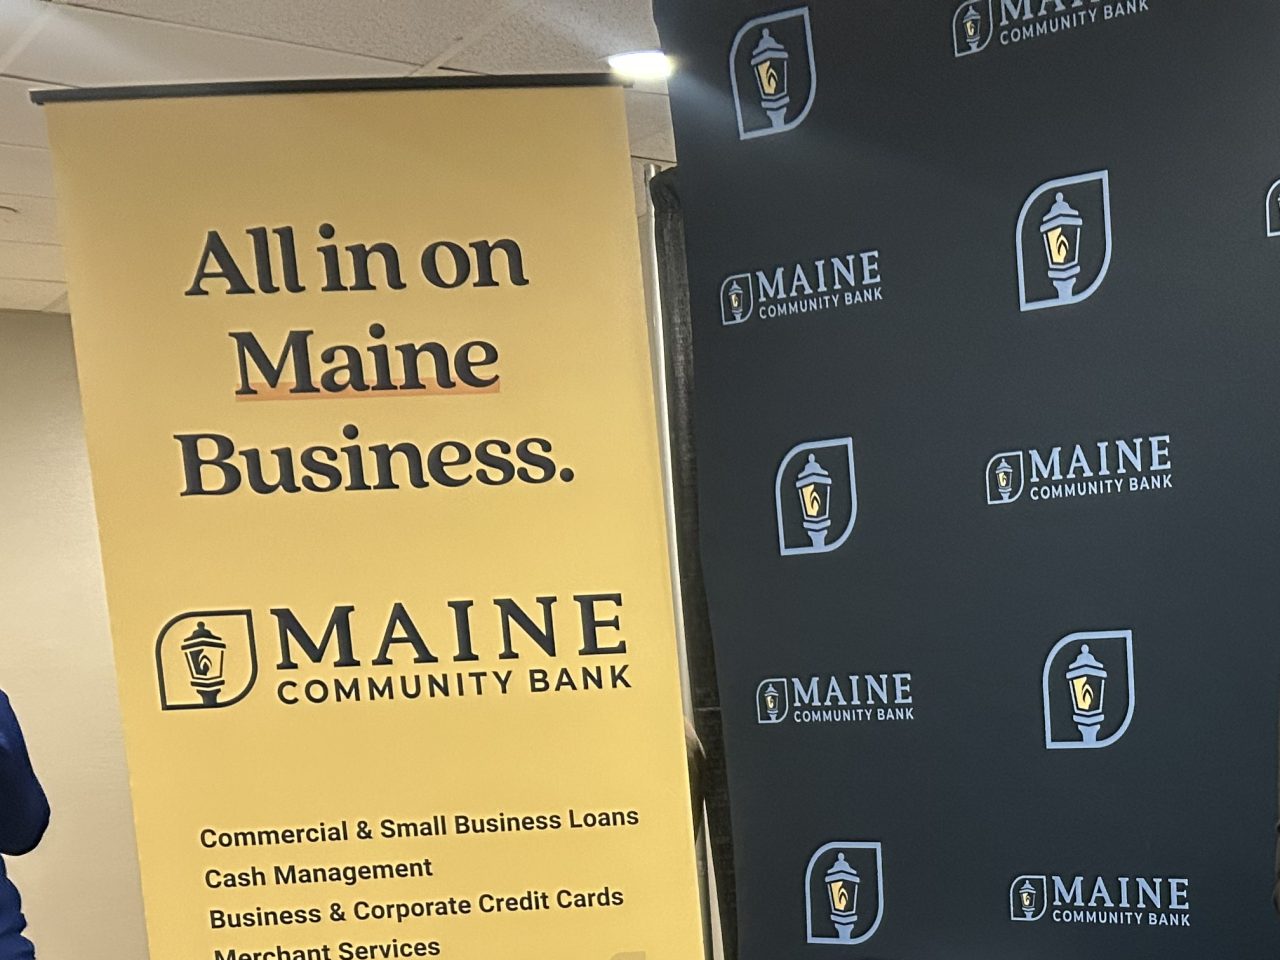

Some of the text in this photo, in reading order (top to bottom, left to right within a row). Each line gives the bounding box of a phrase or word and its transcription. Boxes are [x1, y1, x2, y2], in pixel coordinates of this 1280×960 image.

[1000, 8, 1098, 45] COMMUNITY
[1104, 0, 1149, 20] BANK
[185, 223, 529, 295] All in on
[757, 251, 881, 302] MAINE
[758, 287, 883, 319] COMMUNITY BANK
[230, 323, 499, 395] Maine
[174, 425, 575, 497] Business.
[1030, 435, 1172, 481] MAINE
[1030, 475, 1173, 500] COMMUNITY BANK
[269, 594, 627, 671] MAINE
[277, 665, 631, 705] COMMUNITY BANK
[791, 673, 913, 706] MAINE
[794, 706, 914, 723] COMMUNITY BANK
[200, 807, 639, 849] Commercial & Small Business Loans
[204, 858, 433, 890] Cash Management
[1052, 876, 1189, 909] MAINE
[210, 887, 624, 930] Business & Corporate Credit Cards
[1052, 909, 1190, 926] COMMUNITY BANK
[338, 938, 440, 960] Services
